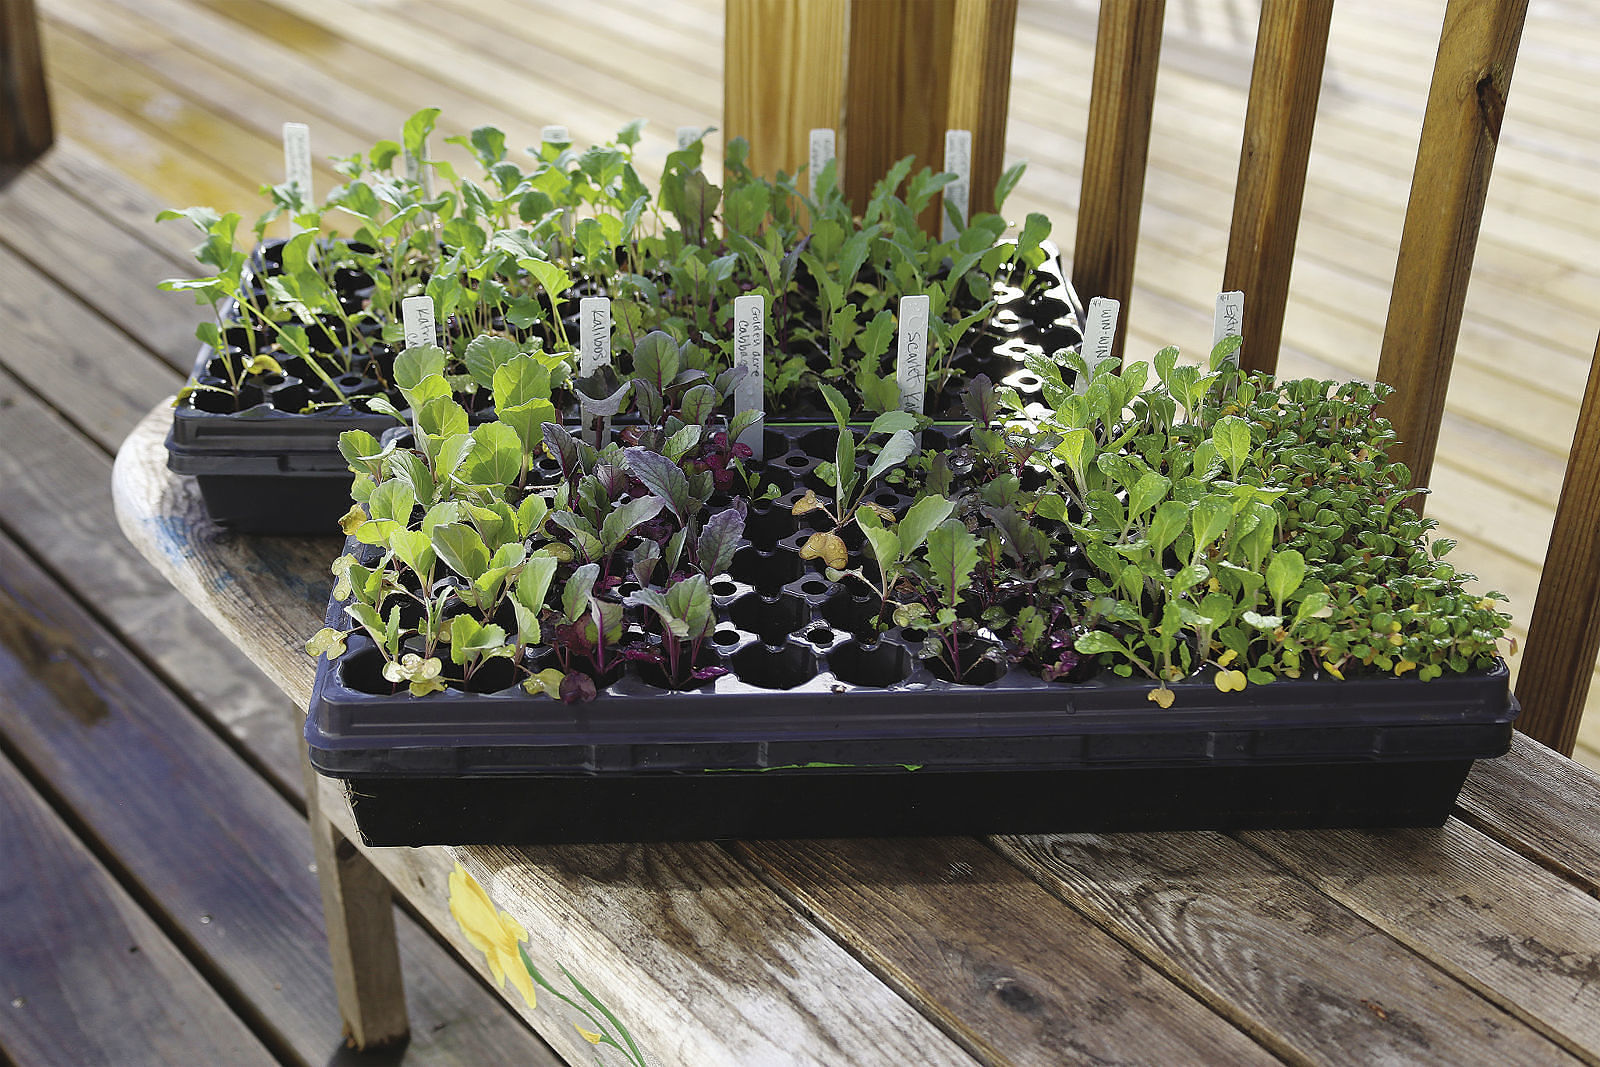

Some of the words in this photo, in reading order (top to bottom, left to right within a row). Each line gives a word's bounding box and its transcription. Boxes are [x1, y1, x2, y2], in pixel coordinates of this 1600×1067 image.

[416, 308, 433, 342] Katri
[591, 310, 607, 361] Kalibos
[738, 320, 750, 366] Cabbag
[751, 306, 762, 347] Golden
[1095, 309, 1111, 359] WIN-WIN
[906, 332, 925, 383] Scarlet
[904, 391, 924, 412] Kal
